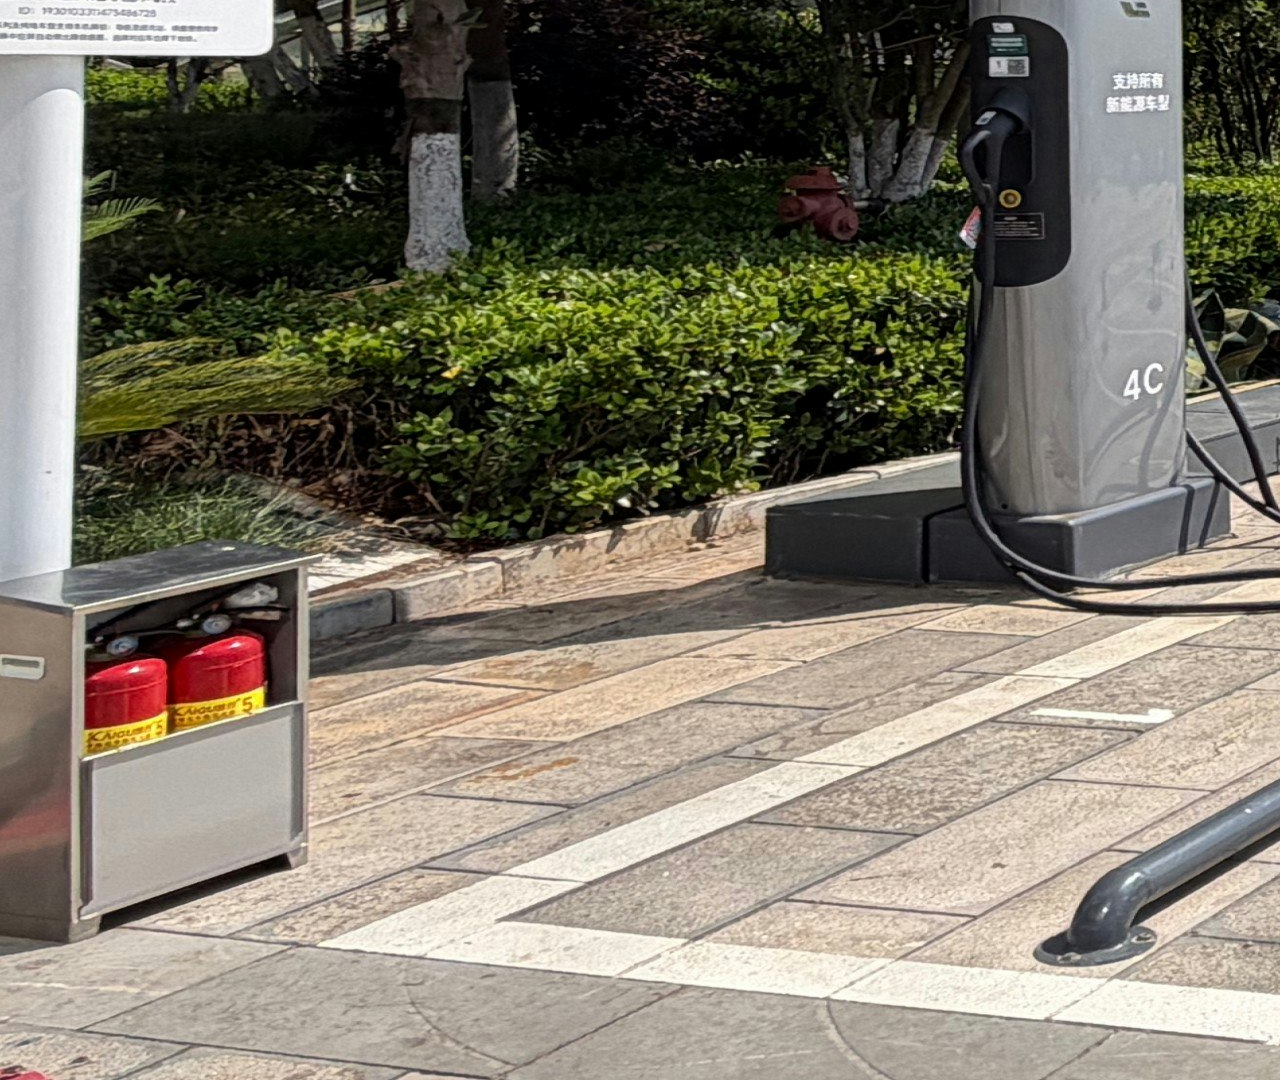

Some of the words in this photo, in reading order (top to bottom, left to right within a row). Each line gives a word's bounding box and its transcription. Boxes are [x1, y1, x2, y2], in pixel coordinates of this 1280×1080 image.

[1111, 72, 1165, 90] 支持所有
[1105, 93, 1171, 114] 新能源车型
[1122, 362, 1165, 401] 4C
